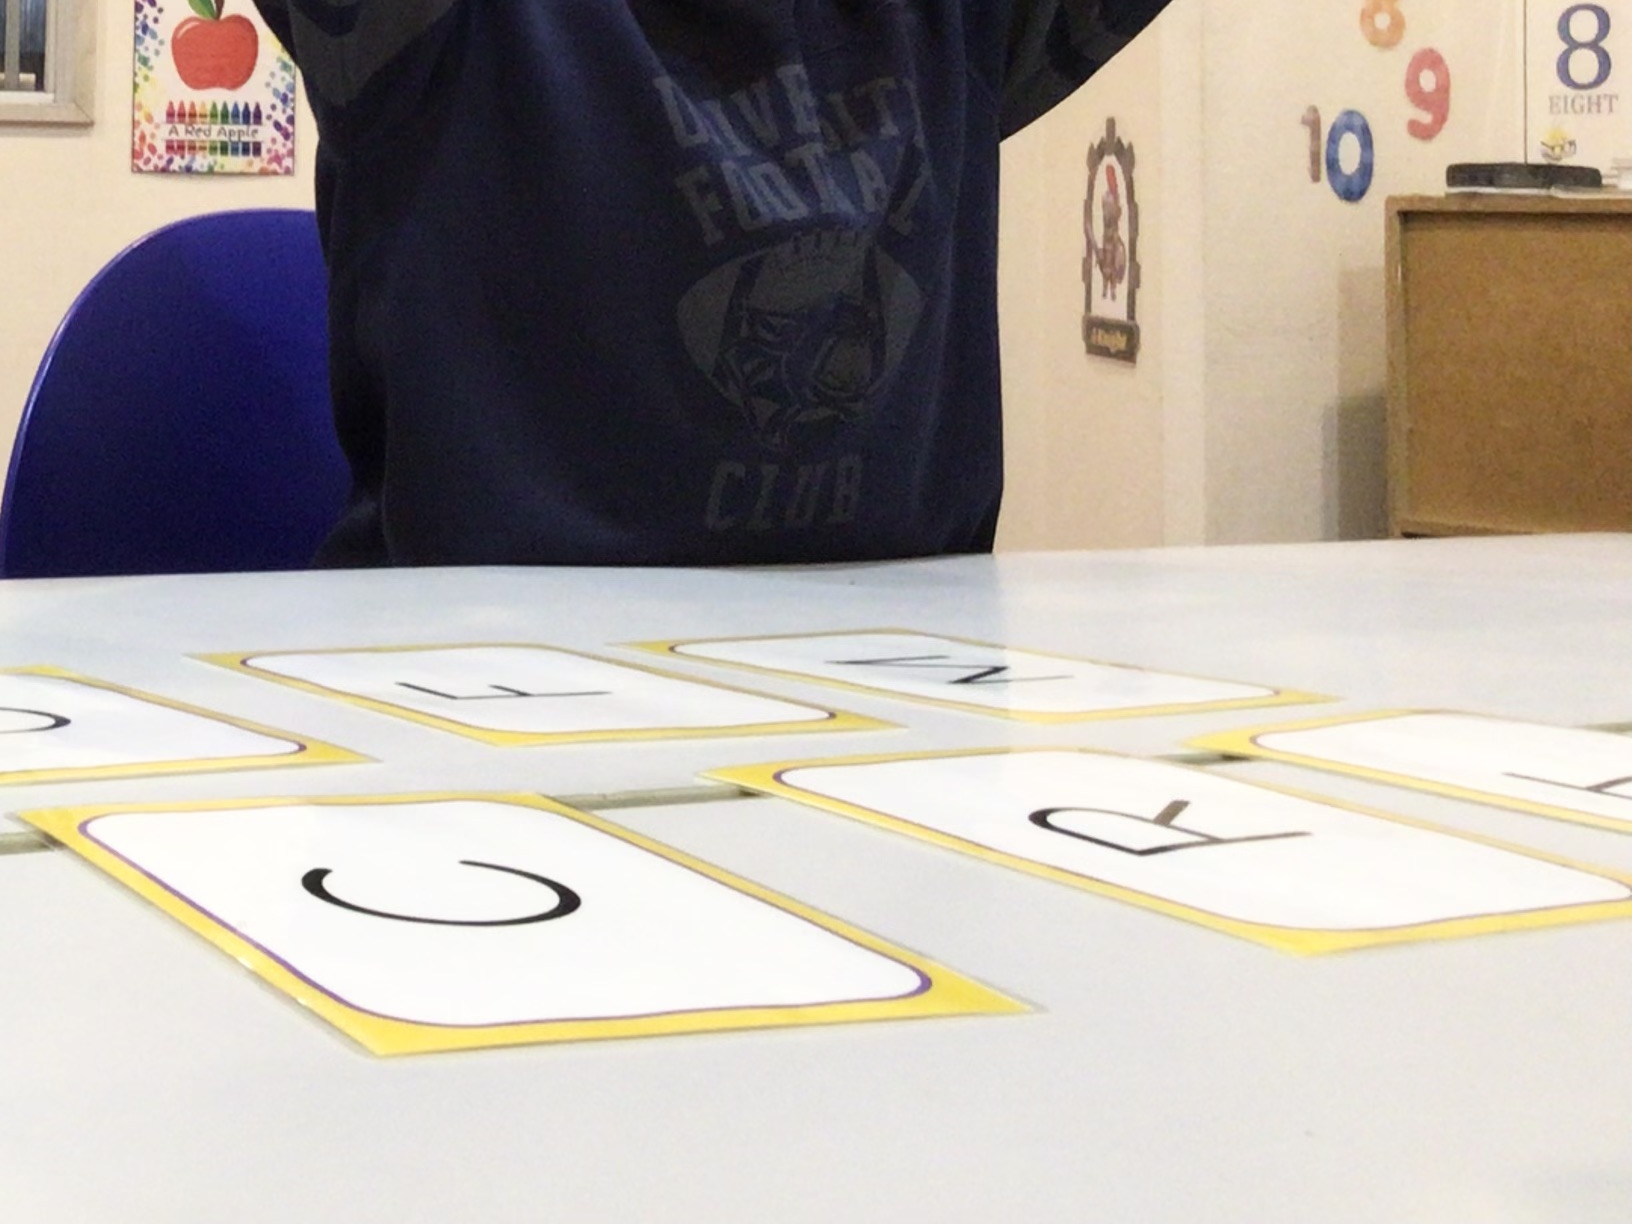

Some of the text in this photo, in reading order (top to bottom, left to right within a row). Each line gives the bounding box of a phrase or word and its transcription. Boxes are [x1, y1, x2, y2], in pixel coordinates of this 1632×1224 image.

[1555, 2, 1612, 90] 8
[1404, 48, 1451, 141] 9
[1547, 92, 1619, 117] EIGHT
[167, 123, 259, 142] A Red Apple
[1300, 105, 1374, 204] 10
[1028, 799, 1310, 857] R
[300, 860, 581, 927] C
